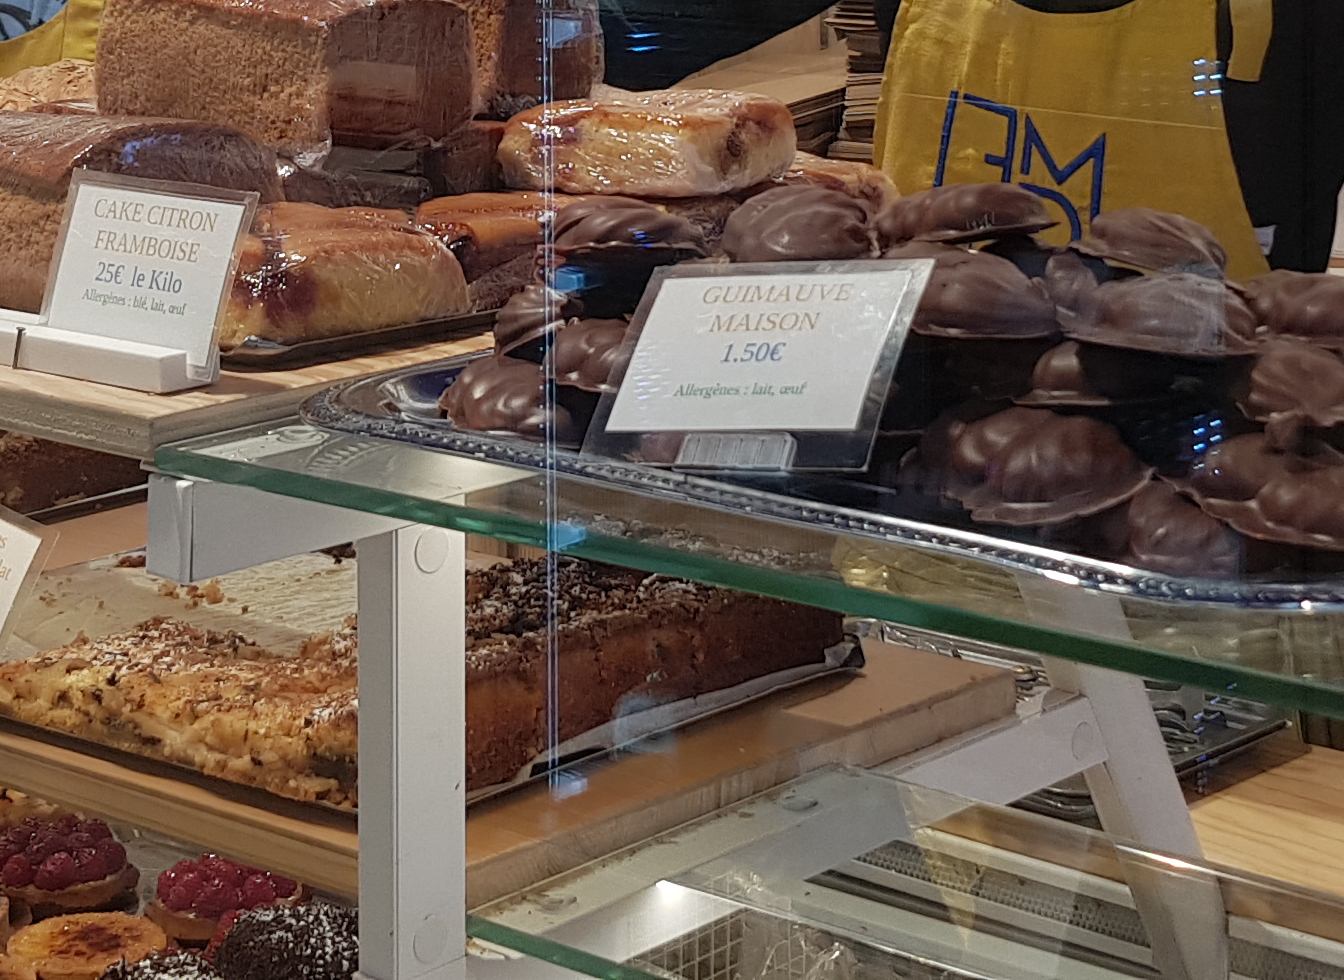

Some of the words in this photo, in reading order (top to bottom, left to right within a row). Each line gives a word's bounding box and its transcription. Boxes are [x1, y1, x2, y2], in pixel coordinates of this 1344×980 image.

[93, 198, 145, 223] CAKE
[147, 204, 220, 233] CITRON
[94, 229, 201, 263] FRAMBOISE
[94, 260, 125, 285] 25€
[130, 265, 146, 288] le
[148, 269, 183, 294] Kilo
[82, 287, 126, 307] Allergènes
[702, 282, 855, 305] GUIMAUVE
[708, 310, 821, 333] MAISON
[719, 341, 787, 364] 1.50€
[673, 381, 741, 399] Allergènes
